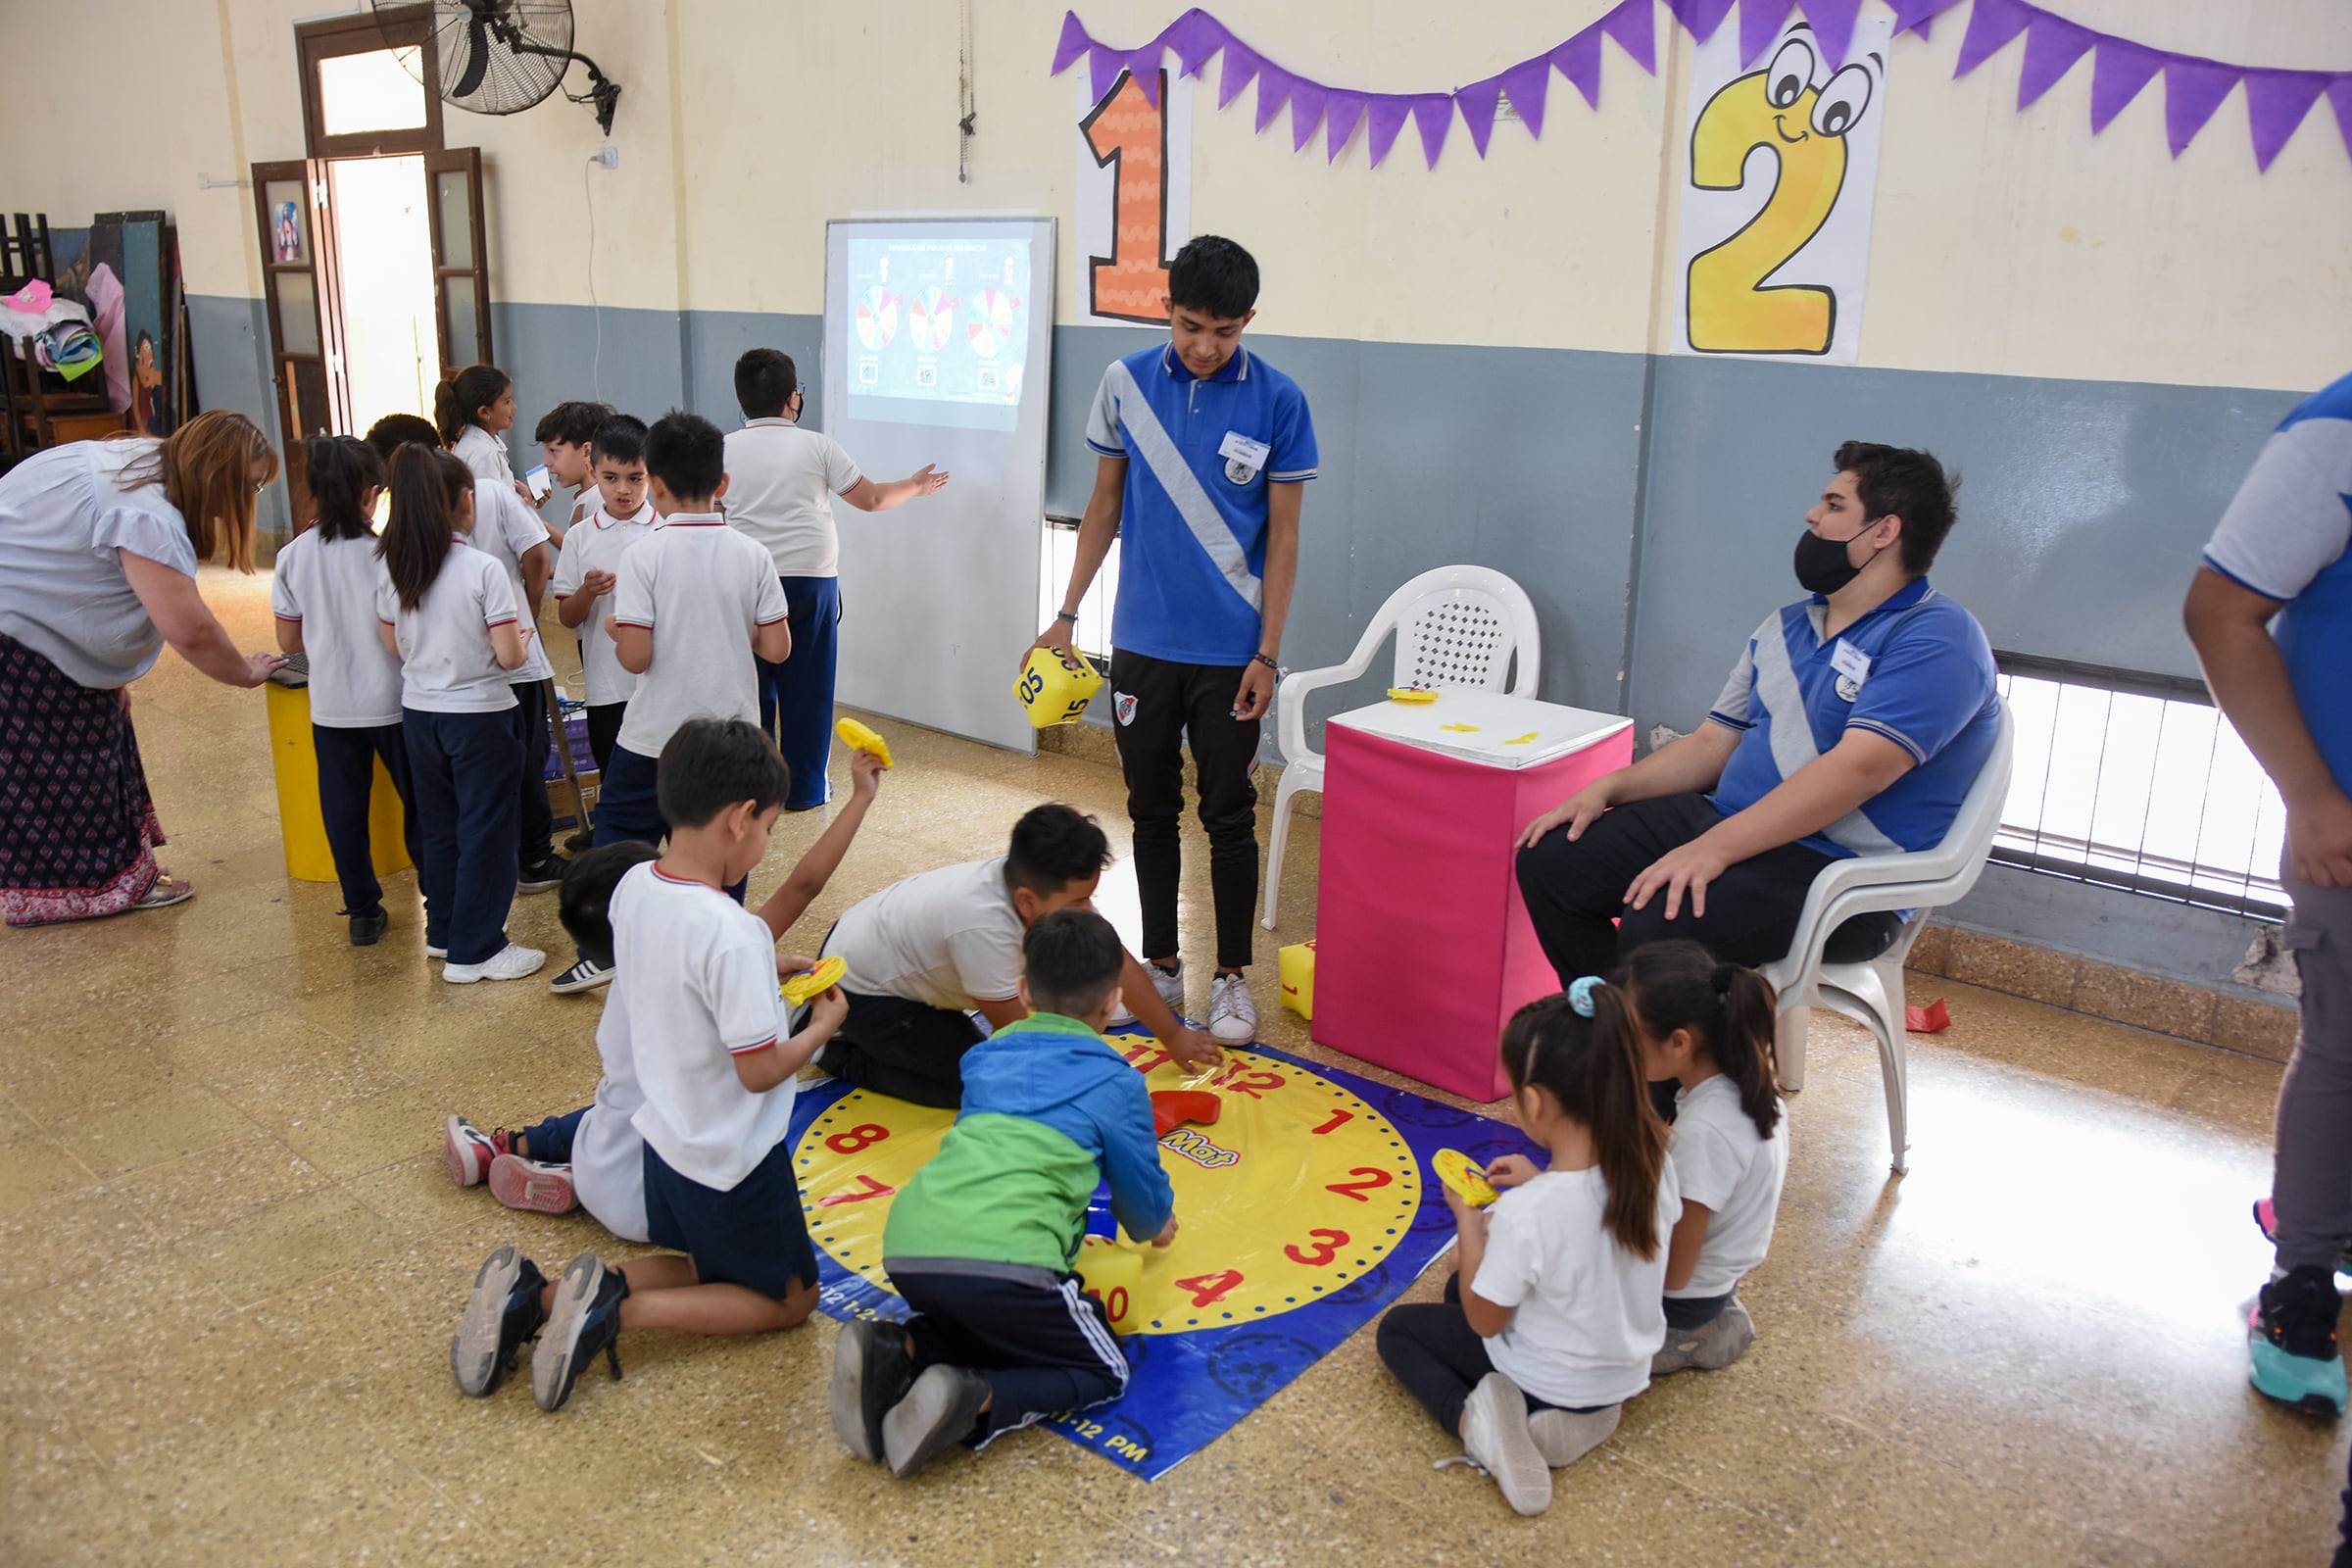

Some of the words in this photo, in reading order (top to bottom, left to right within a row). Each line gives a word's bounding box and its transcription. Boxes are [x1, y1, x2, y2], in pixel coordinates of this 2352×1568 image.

[1079, 68, 1172, 326] 1
[1687, 69, 1848, 356] 2
[1210, 1058, 1286, 1100] 12
[824, 1123, 890, 1154] 8
[1311, 1108, 1354, 1135] 1
[1160, 1130, 1239, 1166] Mat
[818, 1174, 896, 1207] 7
[1325, 1167, 1393, 1202] 2
[1284, 1228, 1350, 1266] 3
[1174, 1269, 1245, 1307] 4
[1104, 1435, 1148, 1462] PM
